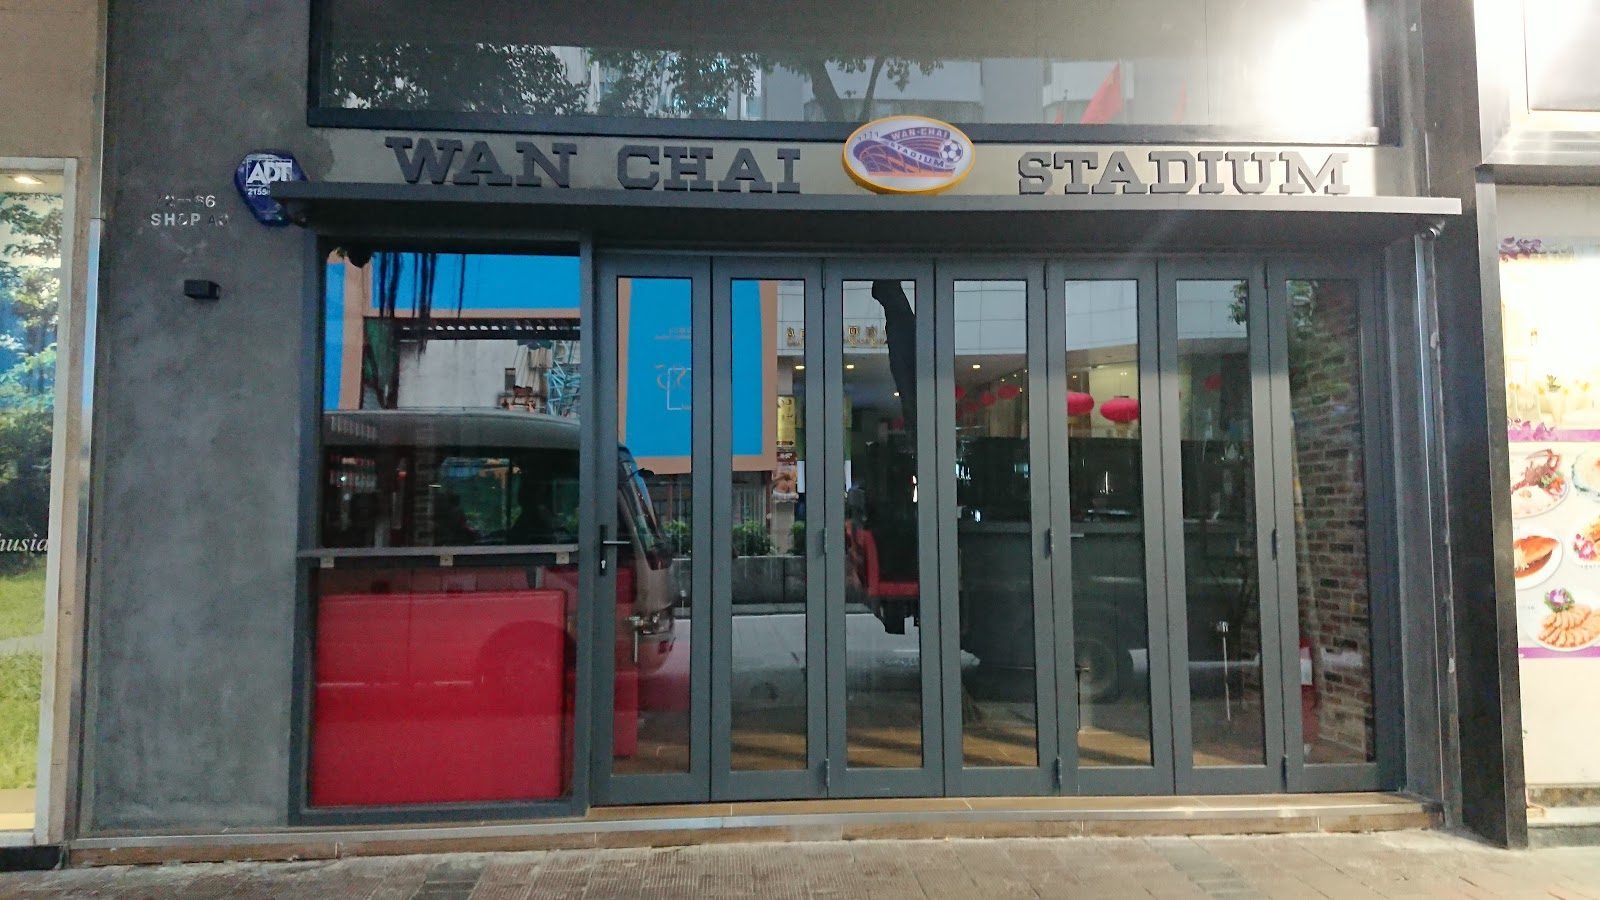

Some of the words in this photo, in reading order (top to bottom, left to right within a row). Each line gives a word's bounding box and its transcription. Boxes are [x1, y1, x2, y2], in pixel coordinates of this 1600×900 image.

[385, 136, 578, 188] WAN
[617, 144, 801, 193] CHAI
[1018, 150, 1350, 196] STADIUM
[890, 141, 945, 168] STADIUM
[246, 160, 292, 185] ADT
